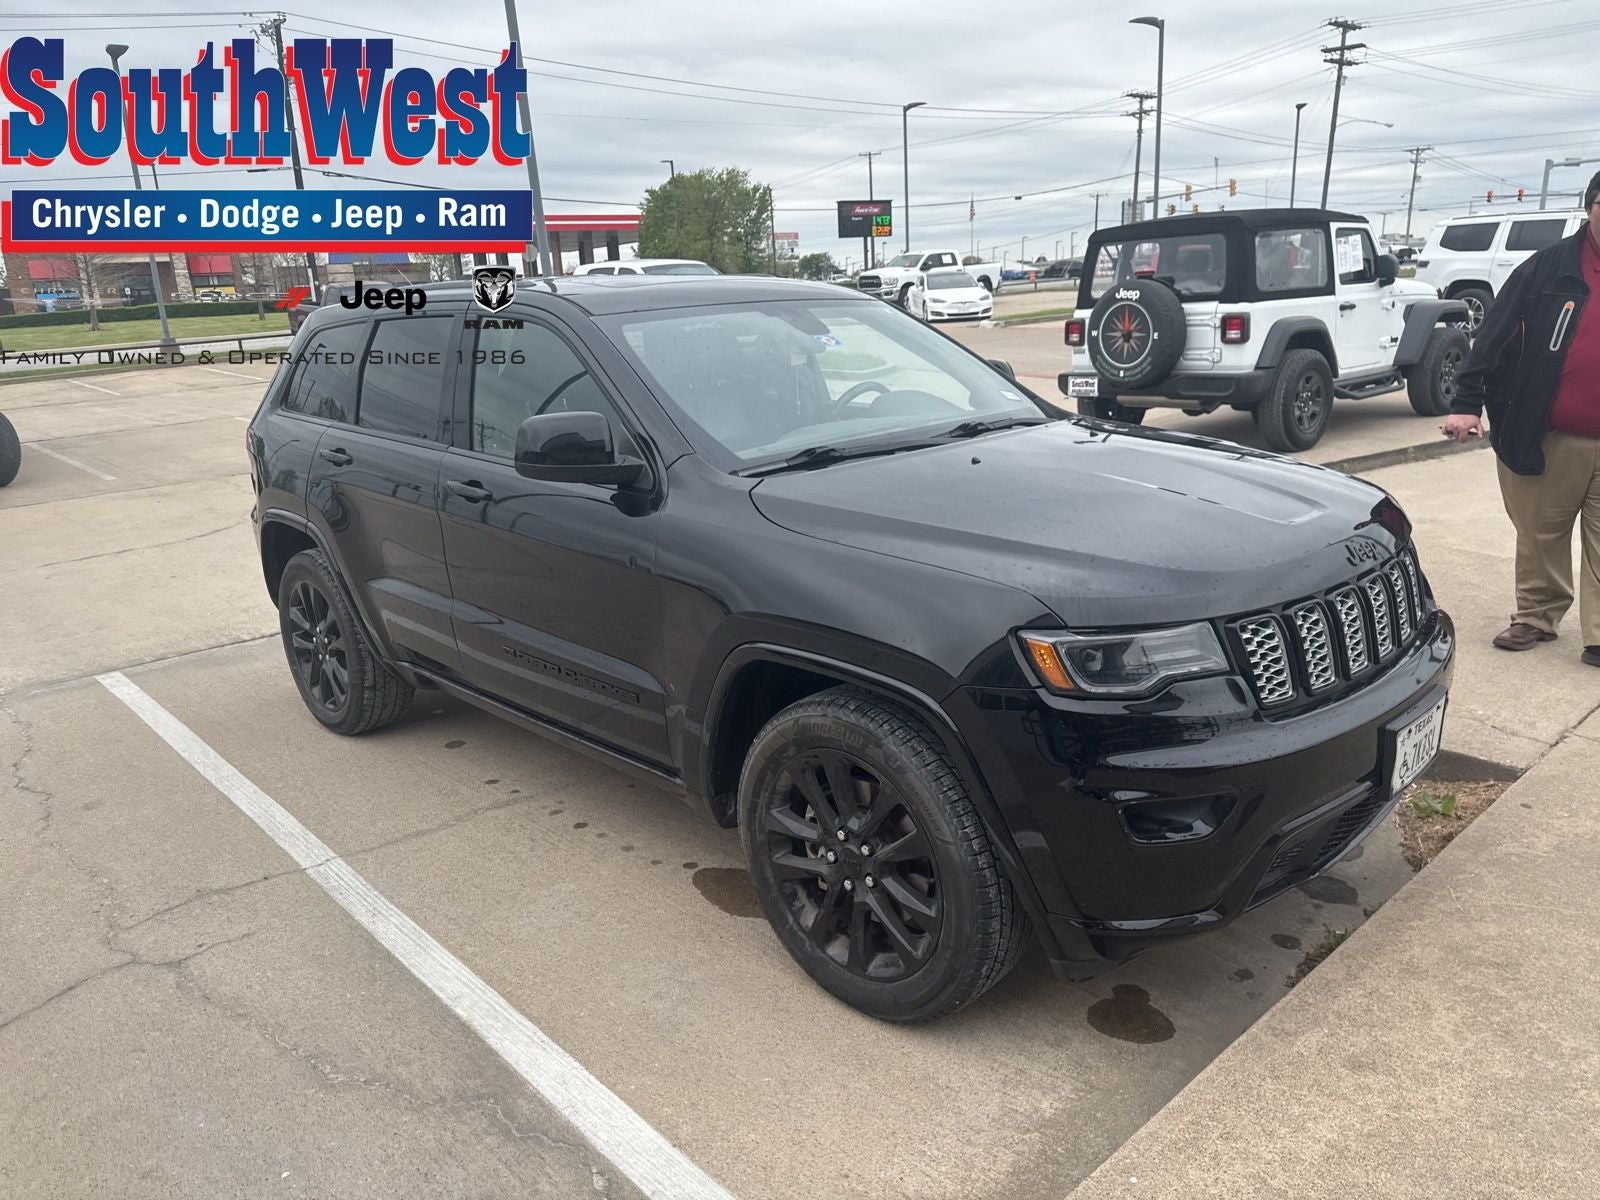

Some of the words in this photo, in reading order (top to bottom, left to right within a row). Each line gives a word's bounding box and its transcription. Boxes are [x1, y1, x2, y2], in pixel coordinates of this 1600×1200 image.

[1115, 287, 1140, 300] Jeep
[1344, 541, 1378, 567] Jeep
[1414, 711, 1434, 735] TEXAS
